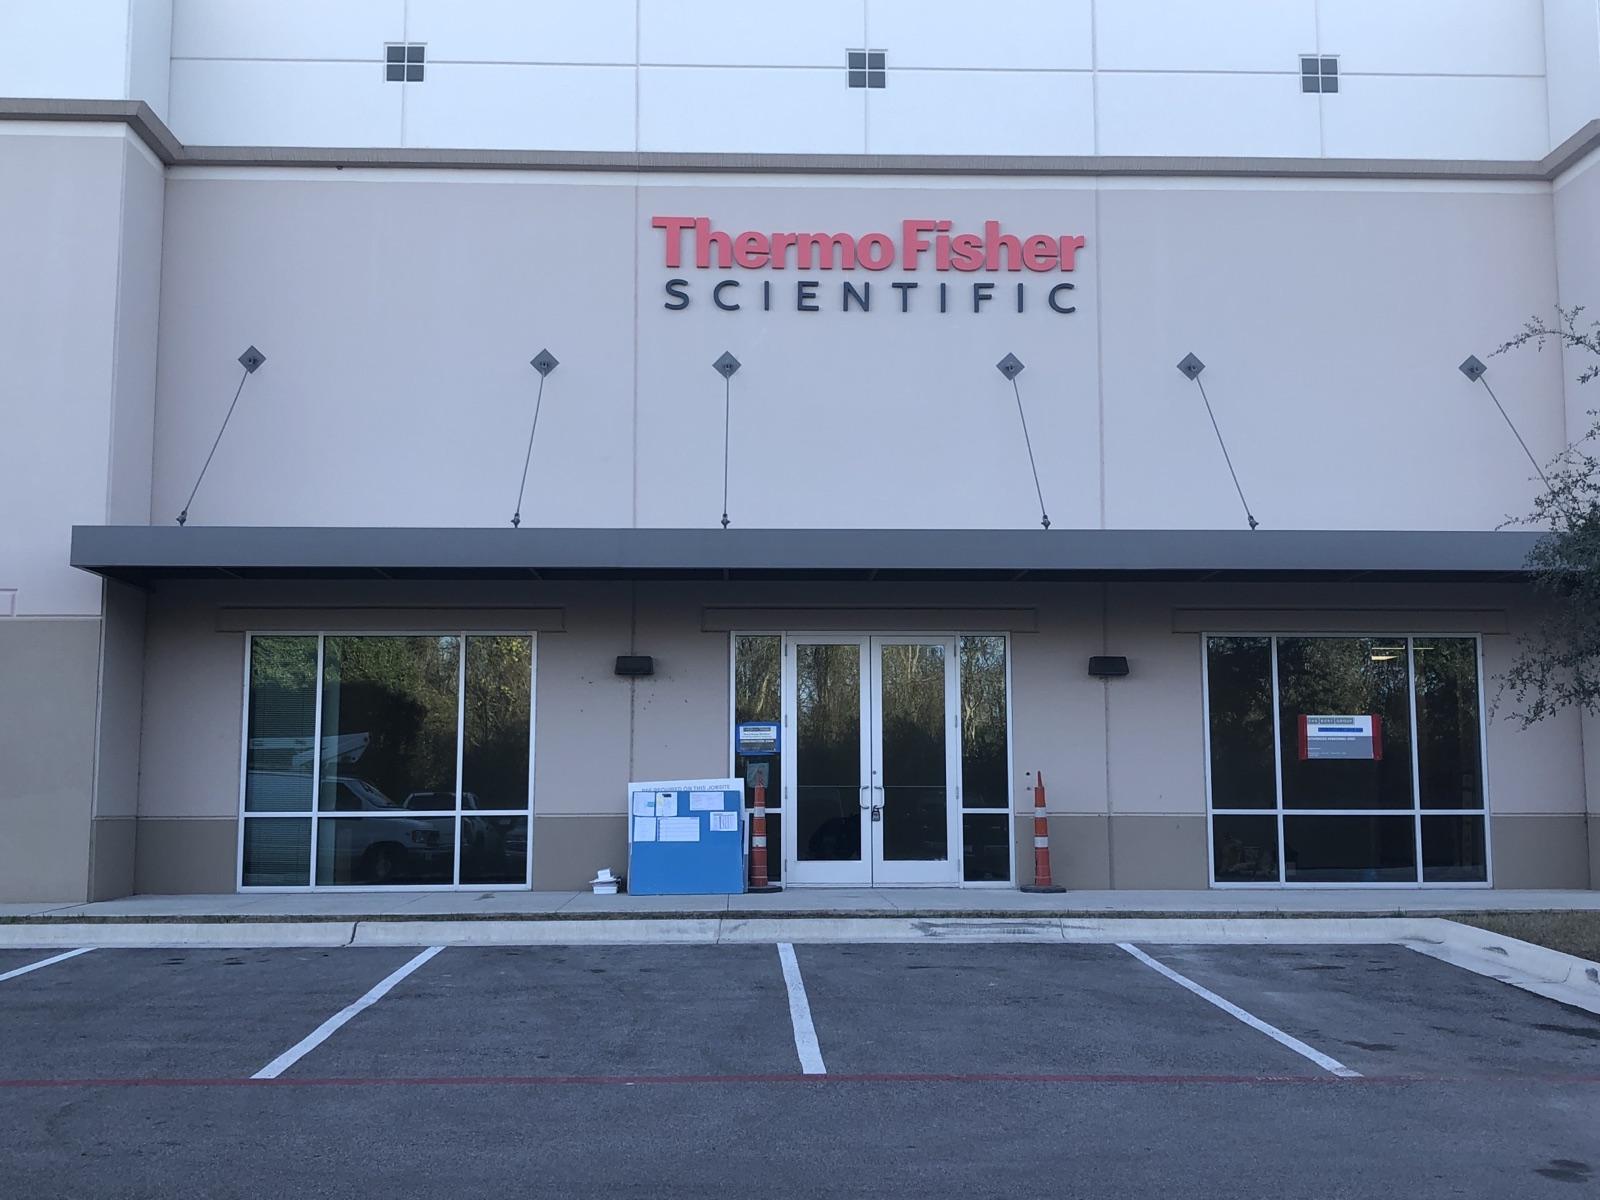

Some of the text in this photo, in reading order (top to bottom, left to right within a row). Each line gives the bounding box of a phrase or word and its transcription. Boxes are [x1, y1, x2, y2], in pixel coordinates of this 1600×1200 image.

[652, 216, 1085, 272] Thermo Fisher
[664, 279, 1077, 314] SCIENTIFIC
